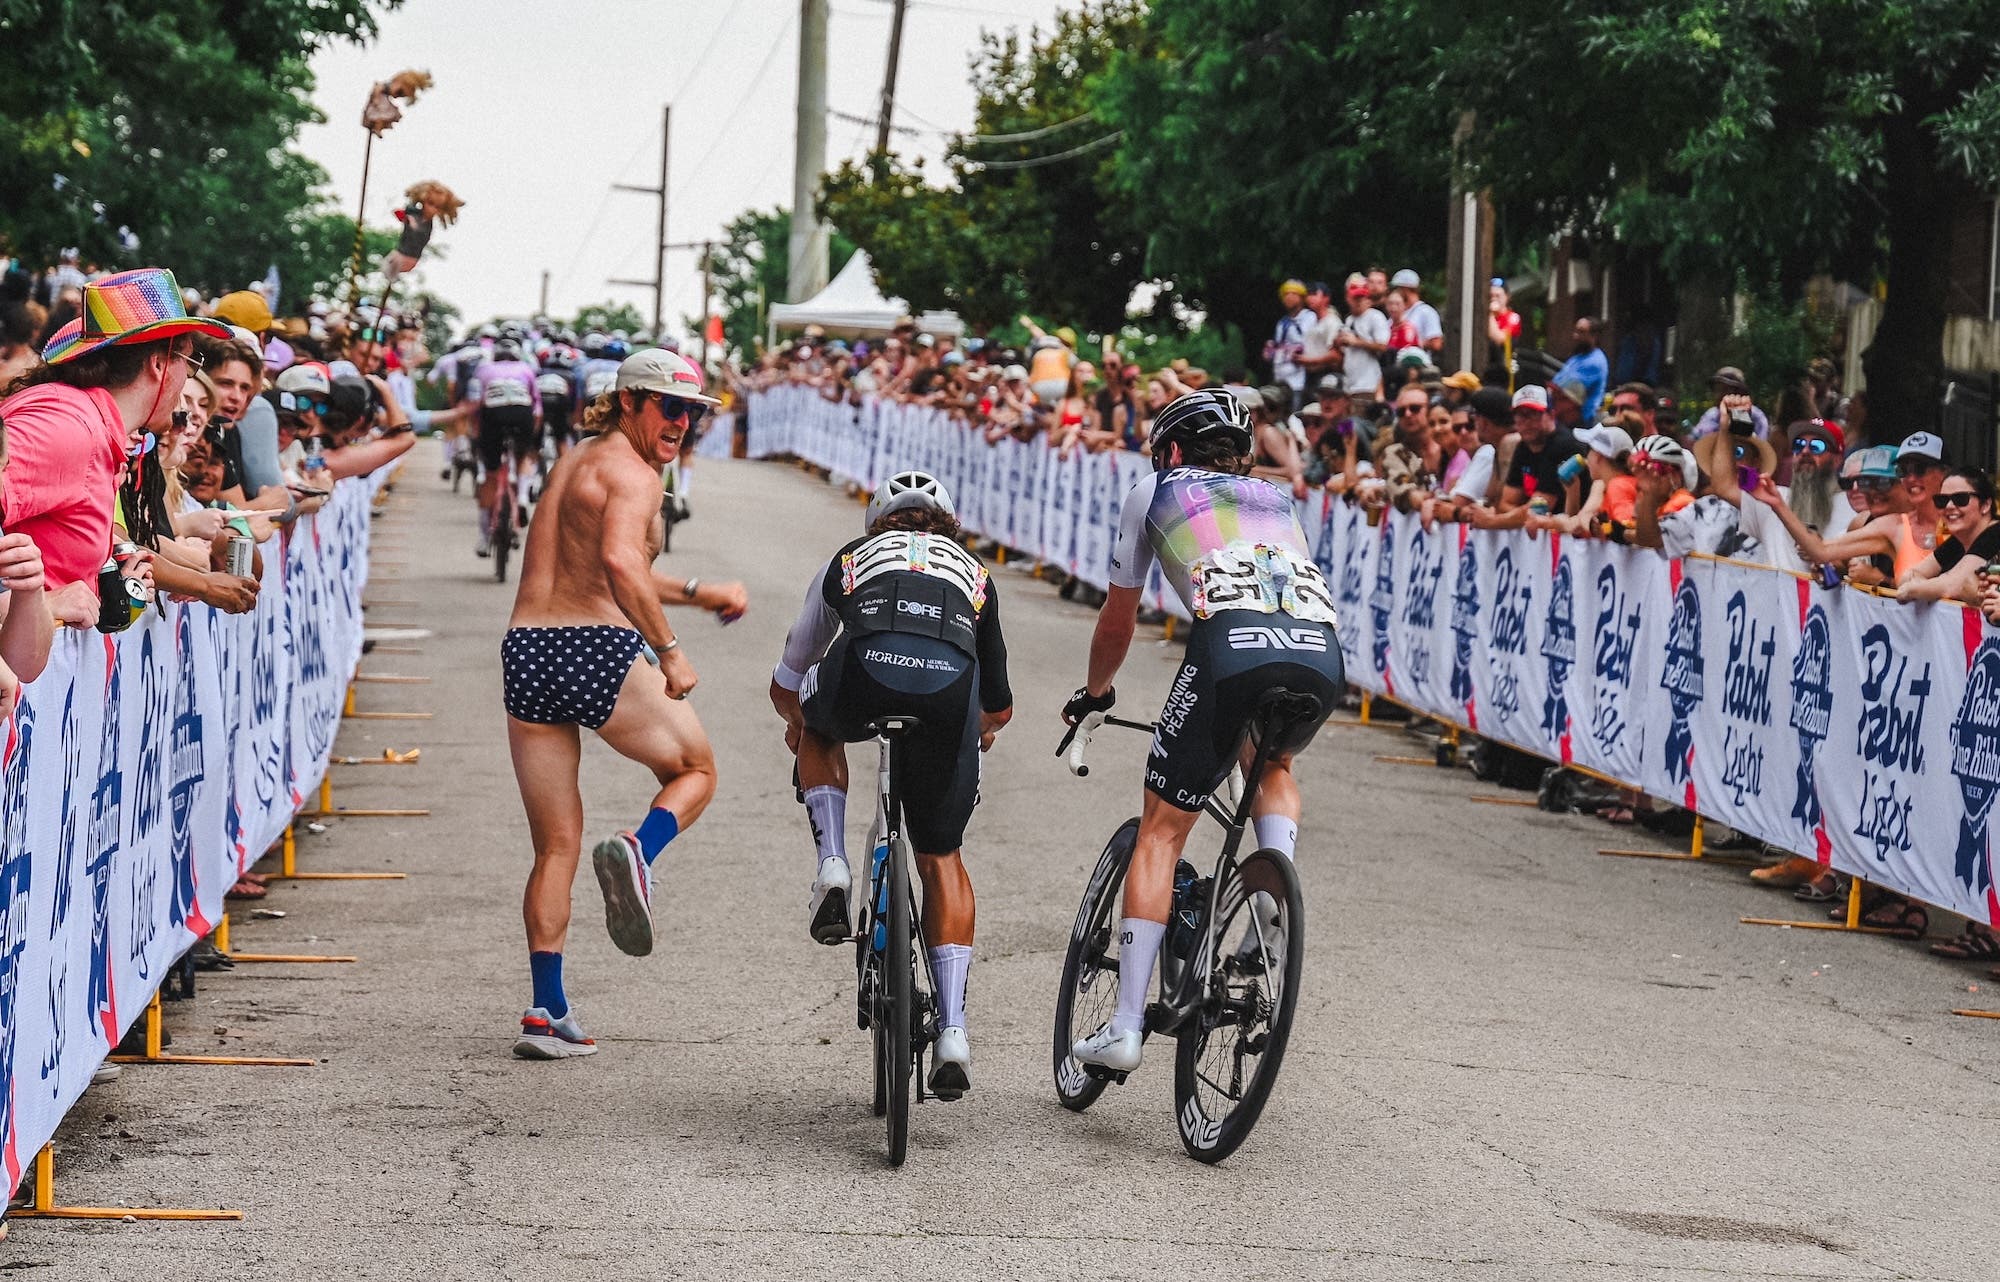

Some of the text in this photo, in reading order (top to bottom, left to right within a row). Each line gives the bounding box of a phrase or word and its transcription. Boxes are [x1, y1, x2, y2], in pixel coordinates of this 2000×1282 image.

[896, 599, 942, 619] CORE
[1204, 561, 1261, 603] 25
[1291, 562, 1336, 613] 25
[1490, 546, 1532, 655] Pabst
[1594, 563, 1642, 690] Pabst
[1722, 589, 1775, 725] Pabst
[1796, 627, 1826, 686] Pabst
[864, 648, 925, 669] HORIZON
[1160, 664, 1198, 727] TRAINING
[1165, 690, 1199, 737] PEAKS
[1856, 623, 1931, 775] Pabst
[1959, 662, 2000, 728] Pabst
[1722, 725, 1763, 807] Light
[1969, 734, 2000, 784] Ribbo
[1177, 788, 1208, 807] CAP
[1853, 769, 1913, 862] Light
